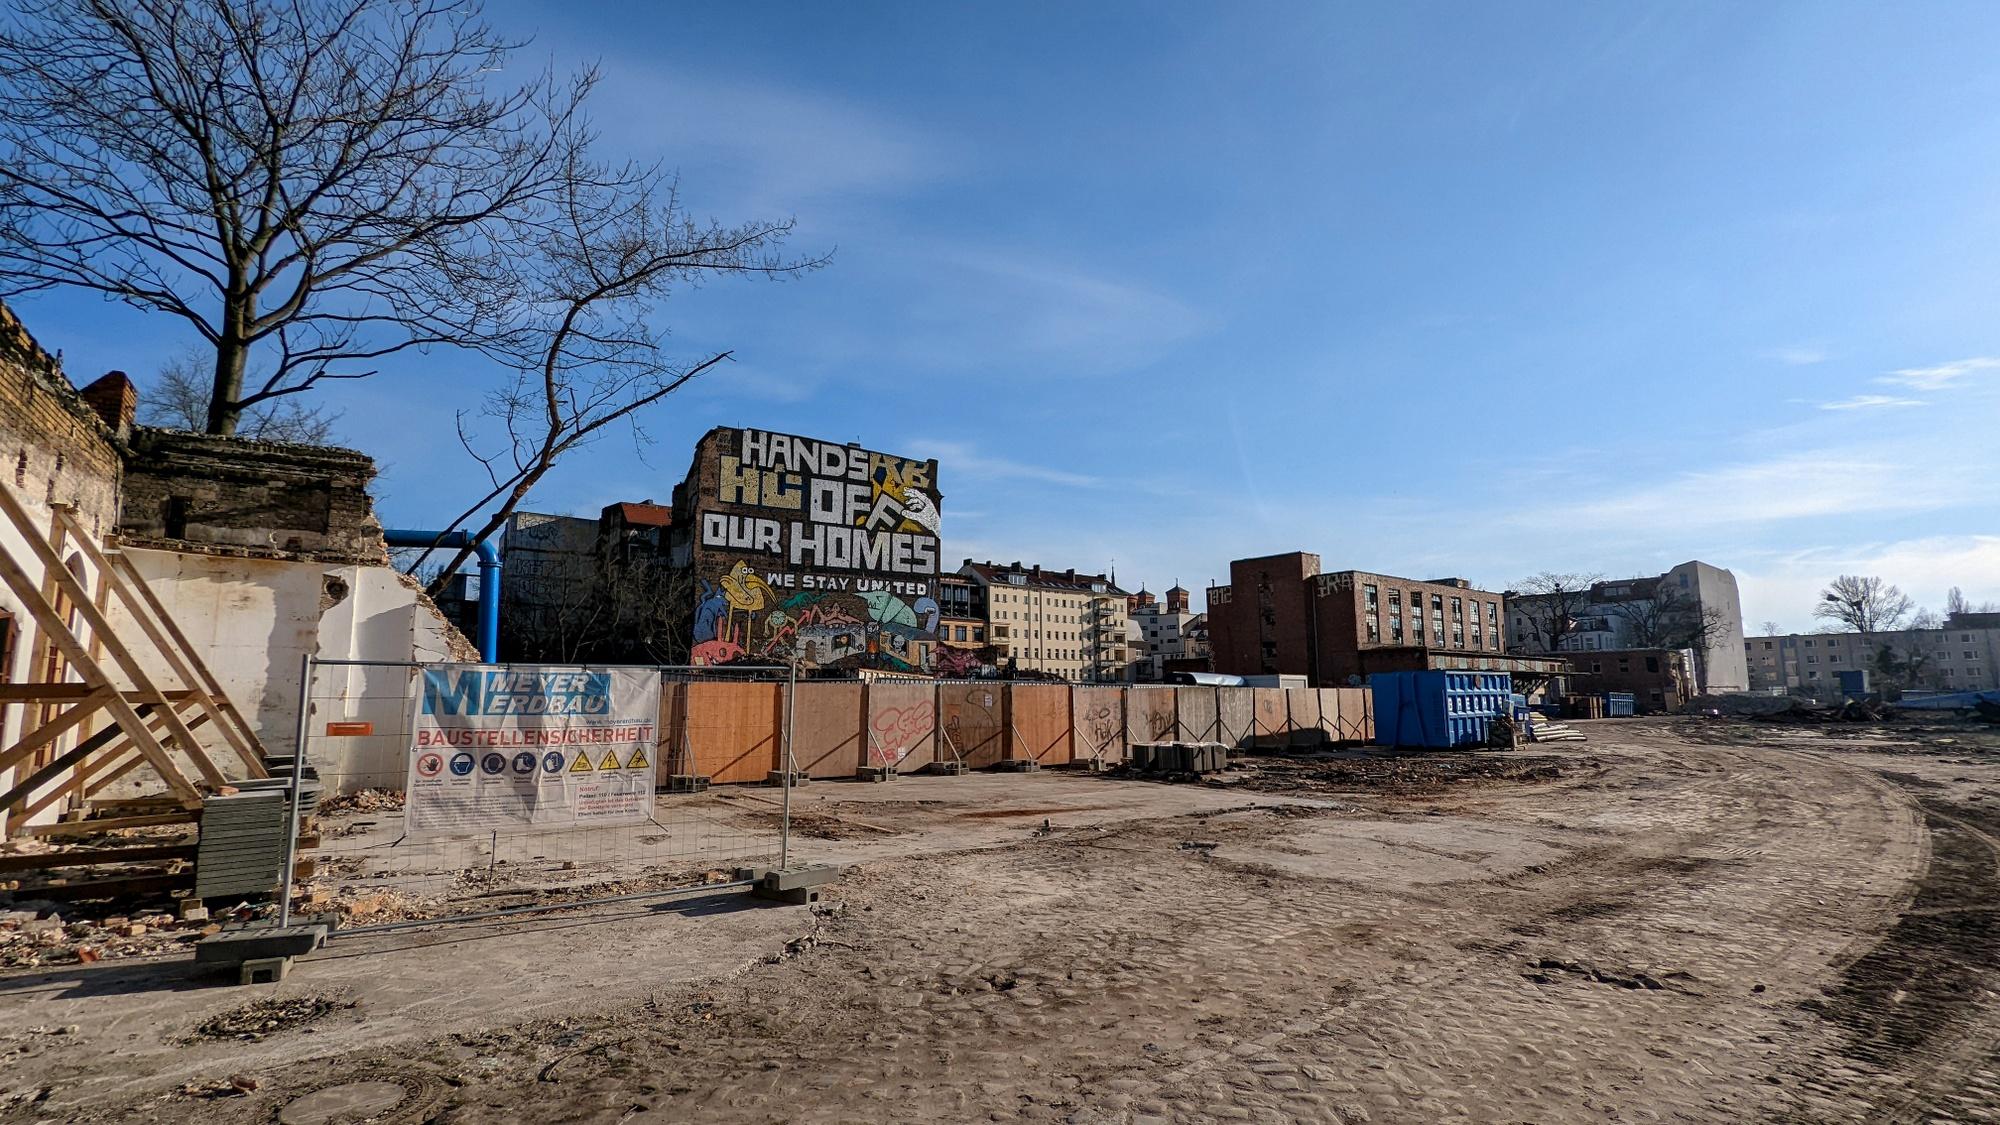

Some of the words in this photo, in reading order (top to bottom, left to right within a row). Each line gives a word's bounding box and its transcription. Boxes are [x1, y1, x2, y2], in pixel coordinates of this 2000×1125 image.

[742, 430, 870, 481] HANDS
[703, 514, 781, 553] OUR
[791, 522, 935, 574] HOMES
[767, 573, 795, 587] WE
[802, 575, 849, 590] STAY
[857, 579, 926, 595] UNITED
[489, 673, 590, 693] MEYER
[487, 695, 607, 714] ERDBAU
[418, 727, 653, 746] BAUSTELLENSICHERHEIT
